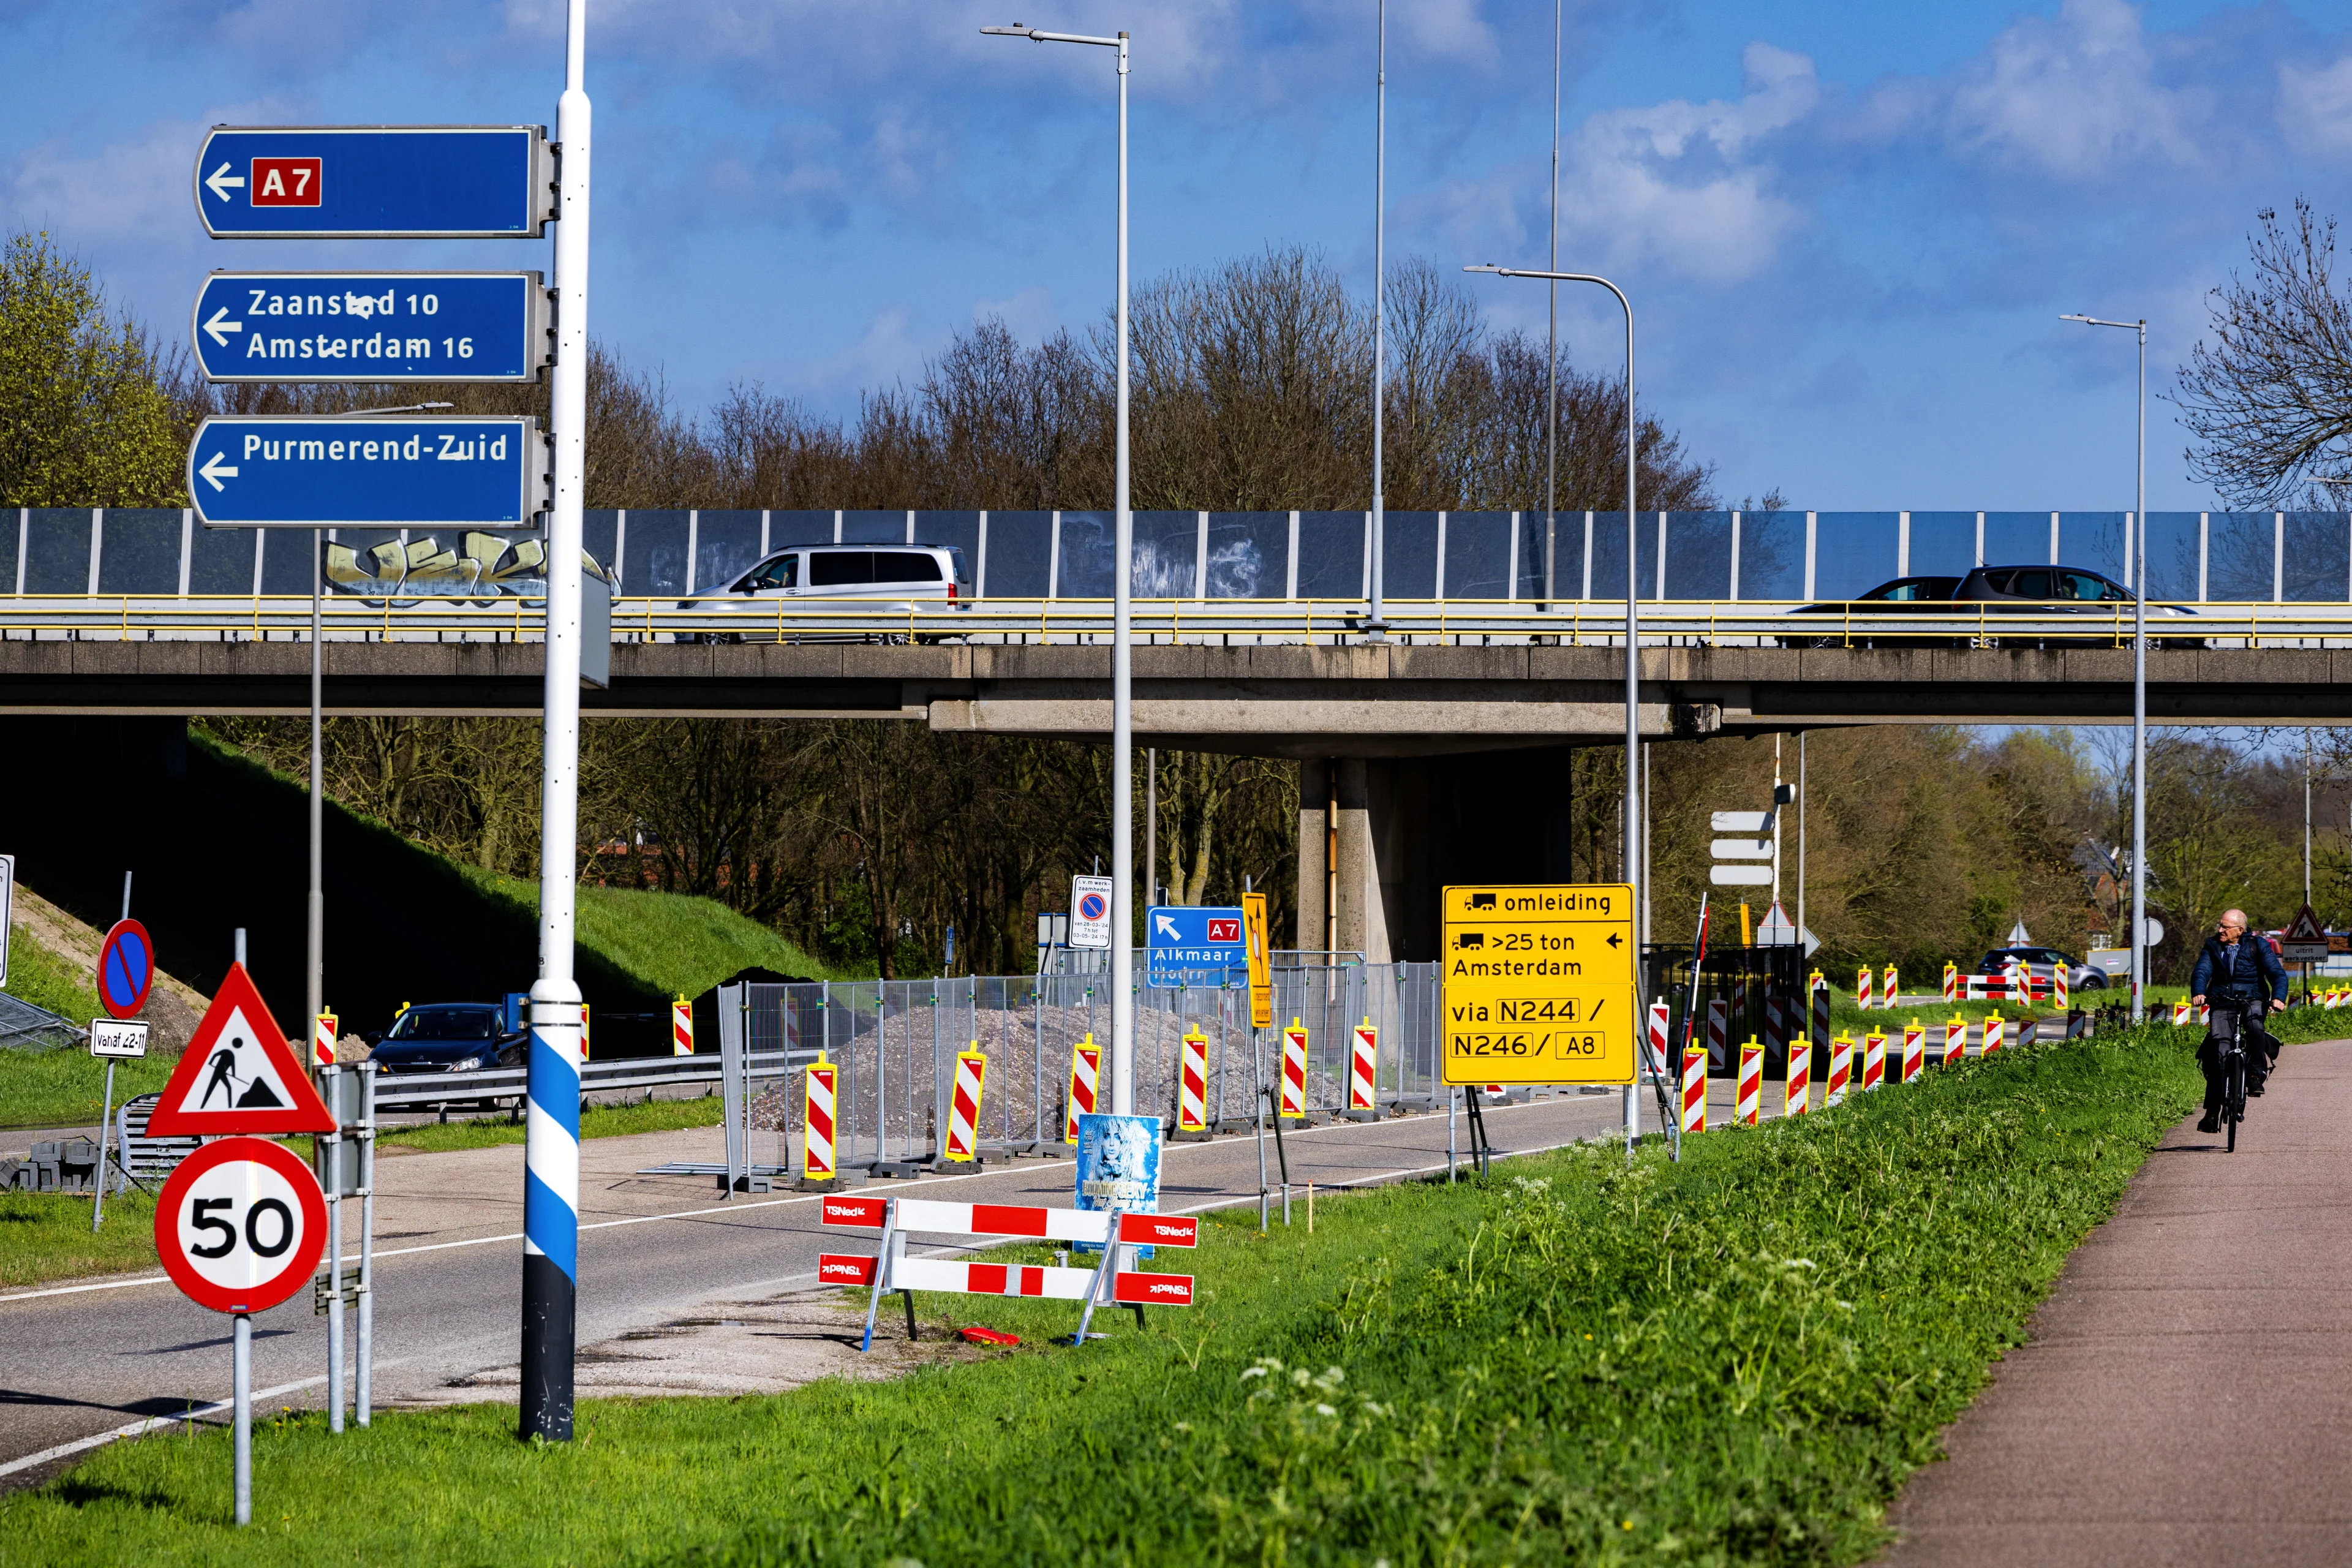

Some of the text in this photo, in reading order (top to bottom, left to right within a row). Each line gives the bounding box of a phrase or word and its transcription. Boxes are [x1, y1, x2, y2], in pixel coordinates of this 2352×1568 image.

[262, 168, 312, 197] A7
[248, 289, 439, 316] Zaanstad 10
[246, 332, 474, 358] Amsterdam 16
[244, 434, 507, 461] Purmerend-Zuid
[1504, 894, 1611, 915] omleiding
[1211, 924, 1237, 937] A7
[1540, 934, 1575, 950] ton
[1154, 949, 1232, 961] Alkmaar
[1452, 959, 1582, 976] Amsterdam
[1452, 1002, 1489, 1022] via
[1501, 1001, 1575, 1022] N244
[1455, 1035, 1527, 1055] N246
[1566, 1036, 1595, 1055] A8
[1118, 1181, 1148, 1199] SEXY
[190, 1197, 294, 1259] 50
